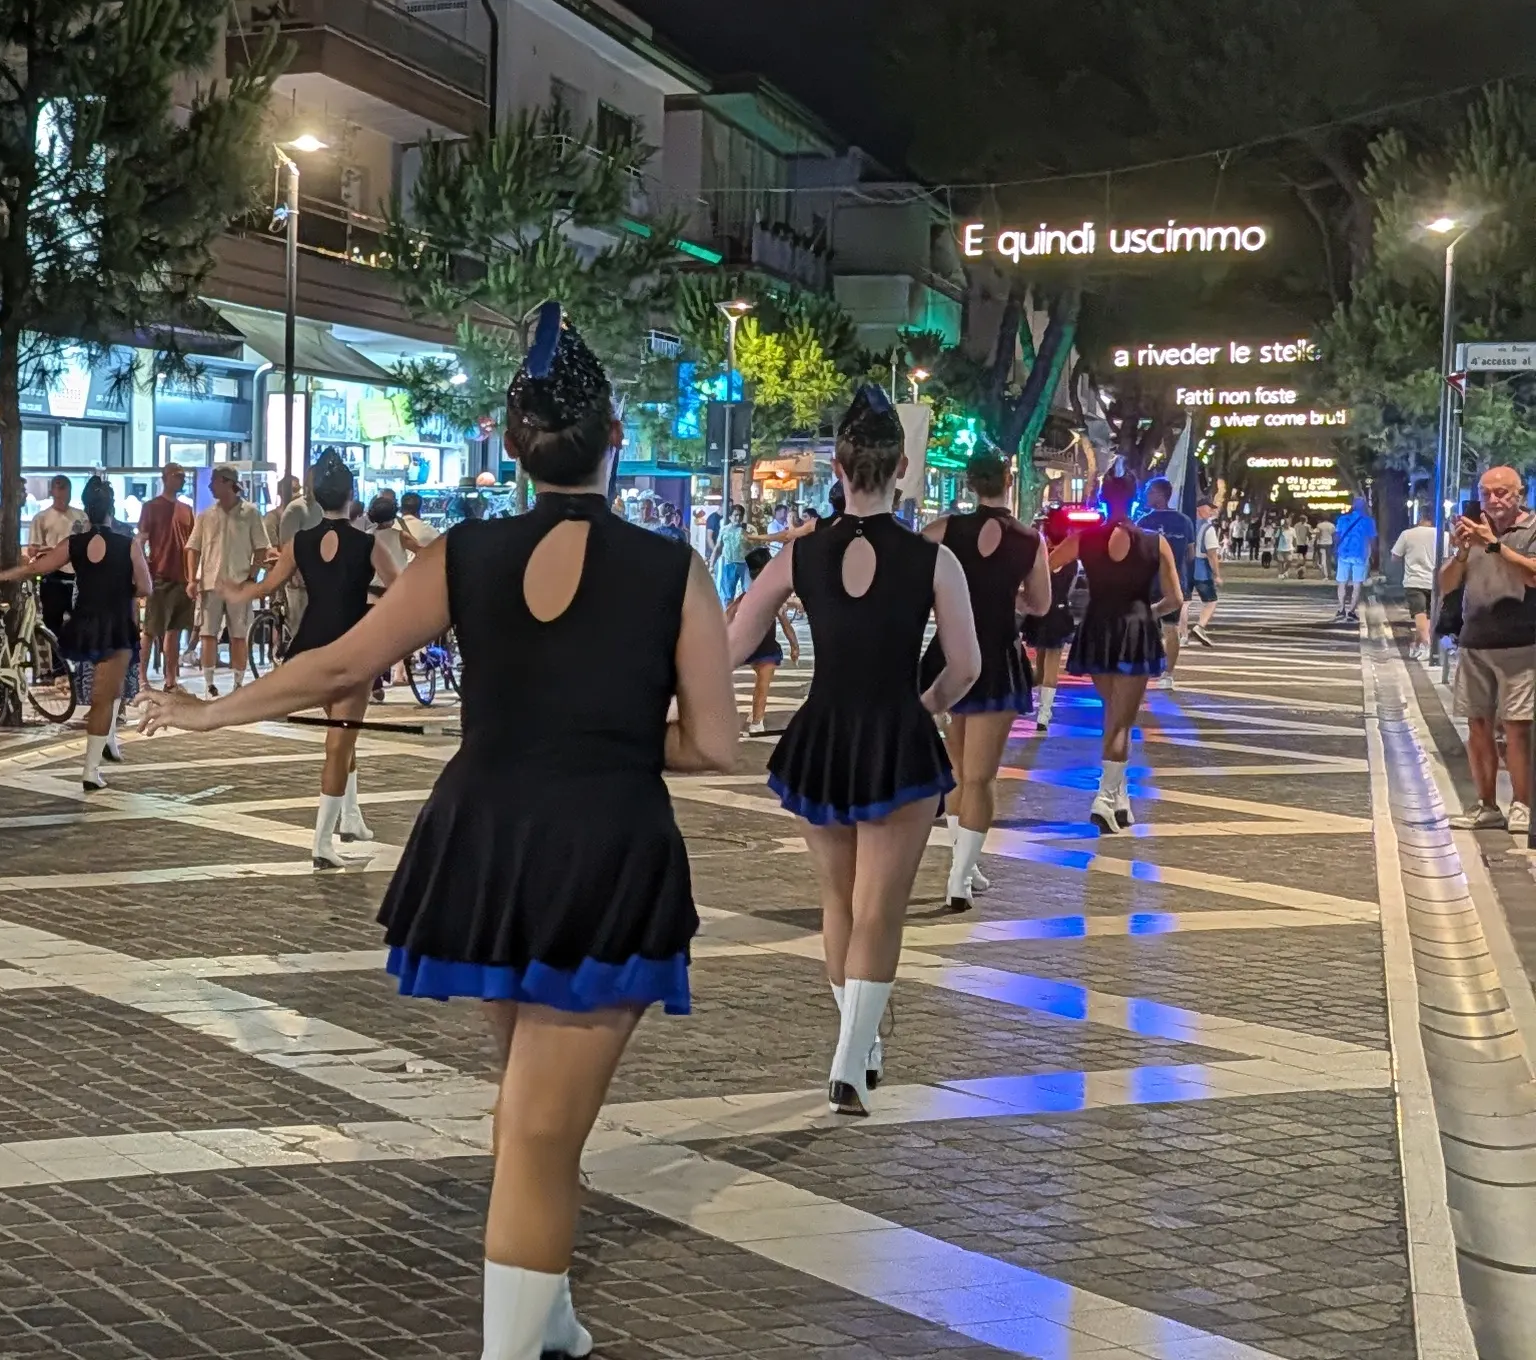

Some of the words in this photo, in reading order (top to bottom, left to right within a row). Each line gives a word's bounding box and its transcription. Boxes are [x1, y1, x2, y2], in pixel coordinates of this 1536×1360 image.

[965, 223, 985, 257] E
[997, 221, 1095, 264] quindi
[1110, 219, 1267, 254] uscimmo
[1114, 349, 1129, 367] a
[1137, 343, 1222, 366] riveder
[1229, 341, 1251, 364] le
[1482, 358, 1517, 366] accesso
[1176, 388, 1214, 405] Fatti
[1218, 391, 1251, 405] non
[1255, 386, 1297, 405] foste
[1210, 415, 1221, 428] a
[1223, 412, 1261, 428] viver
[1264, 412, 1307, 426] come
[1310, 409, 1346, 425] bruti
